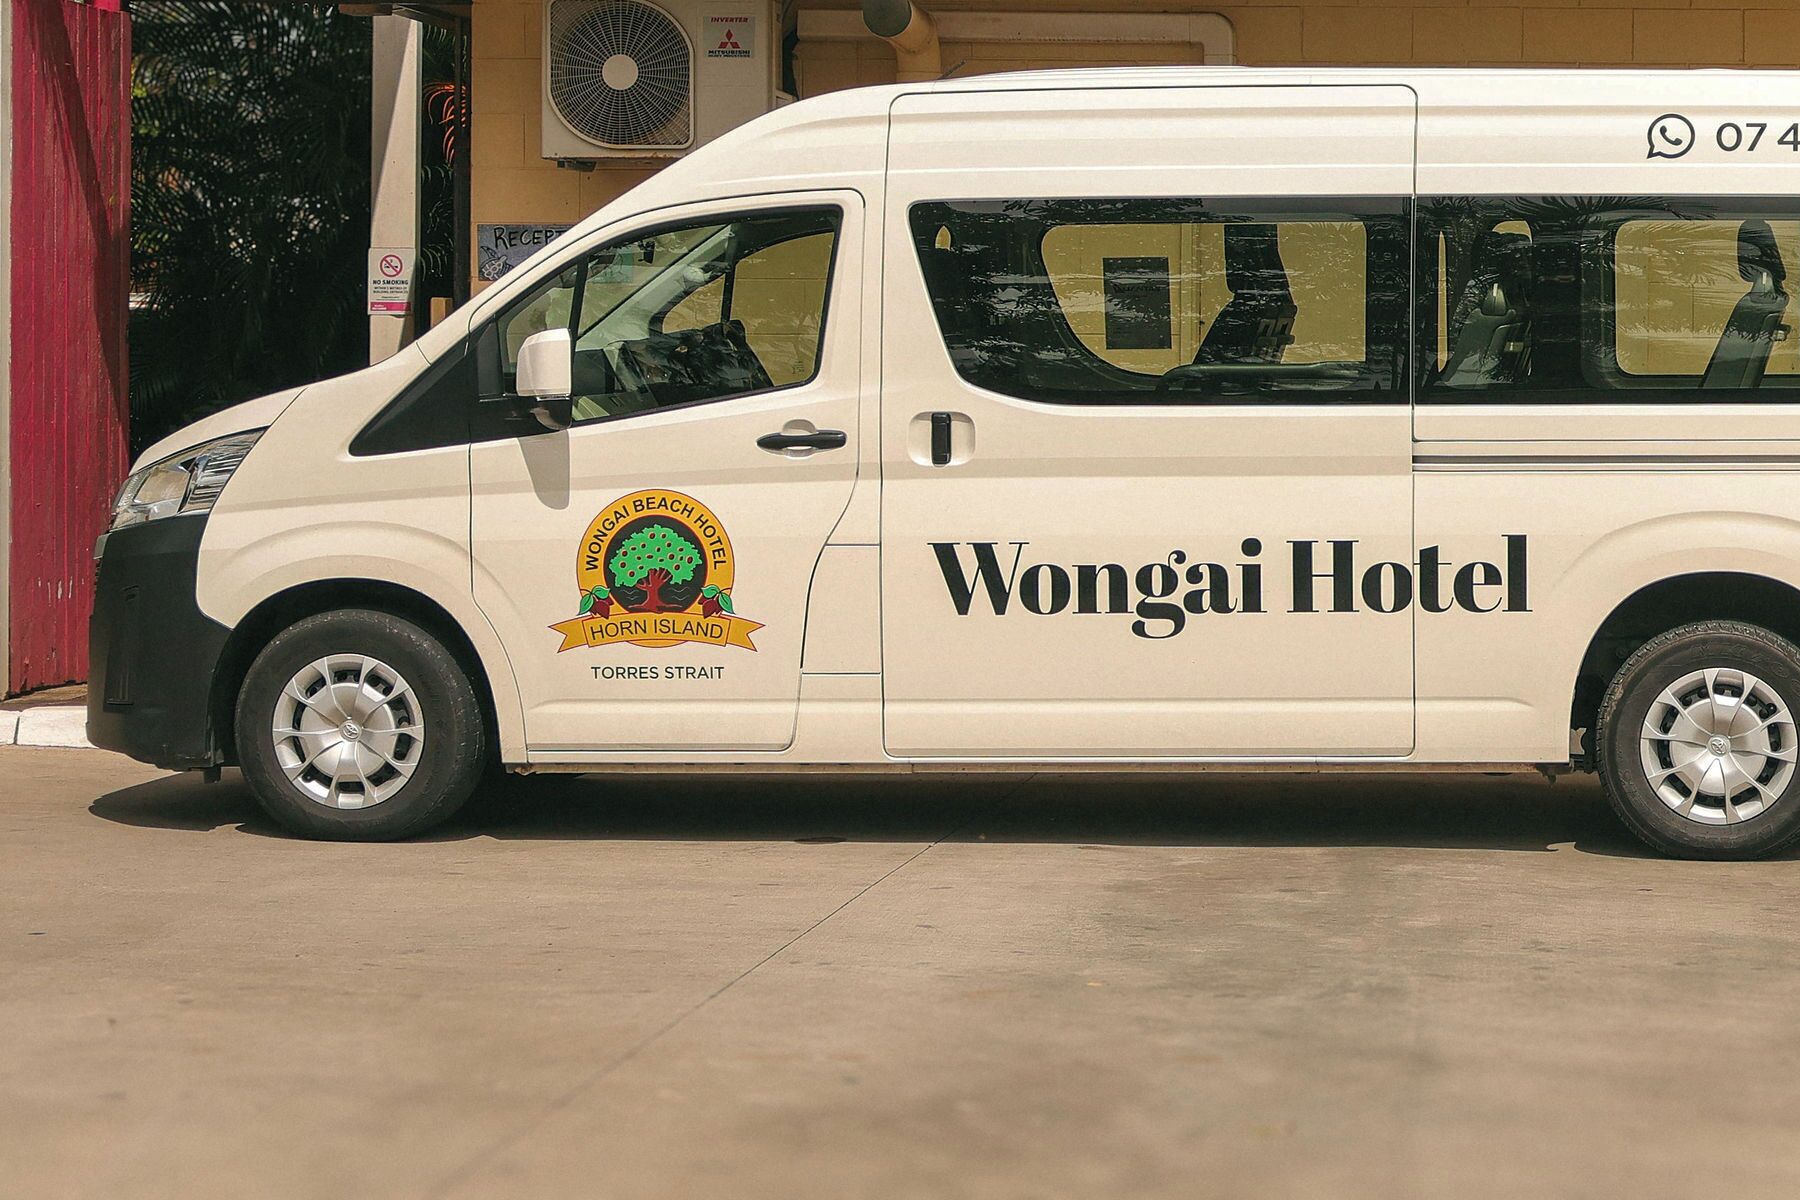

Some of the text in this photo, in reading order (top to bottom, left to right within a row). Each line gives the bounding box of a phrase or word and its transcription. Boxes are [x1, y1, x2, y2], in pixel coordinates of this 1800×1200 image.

[1715, 122, 1768, 152] 07
[585, 497, 727, 571] WONGAI BEACH HOTEL
[927, 534, 1533, 639] Wongai Hotel
[590, 618, 724, 641] HORN ISLAND
[591, 666, 725, 680] TORRES STRAIT
